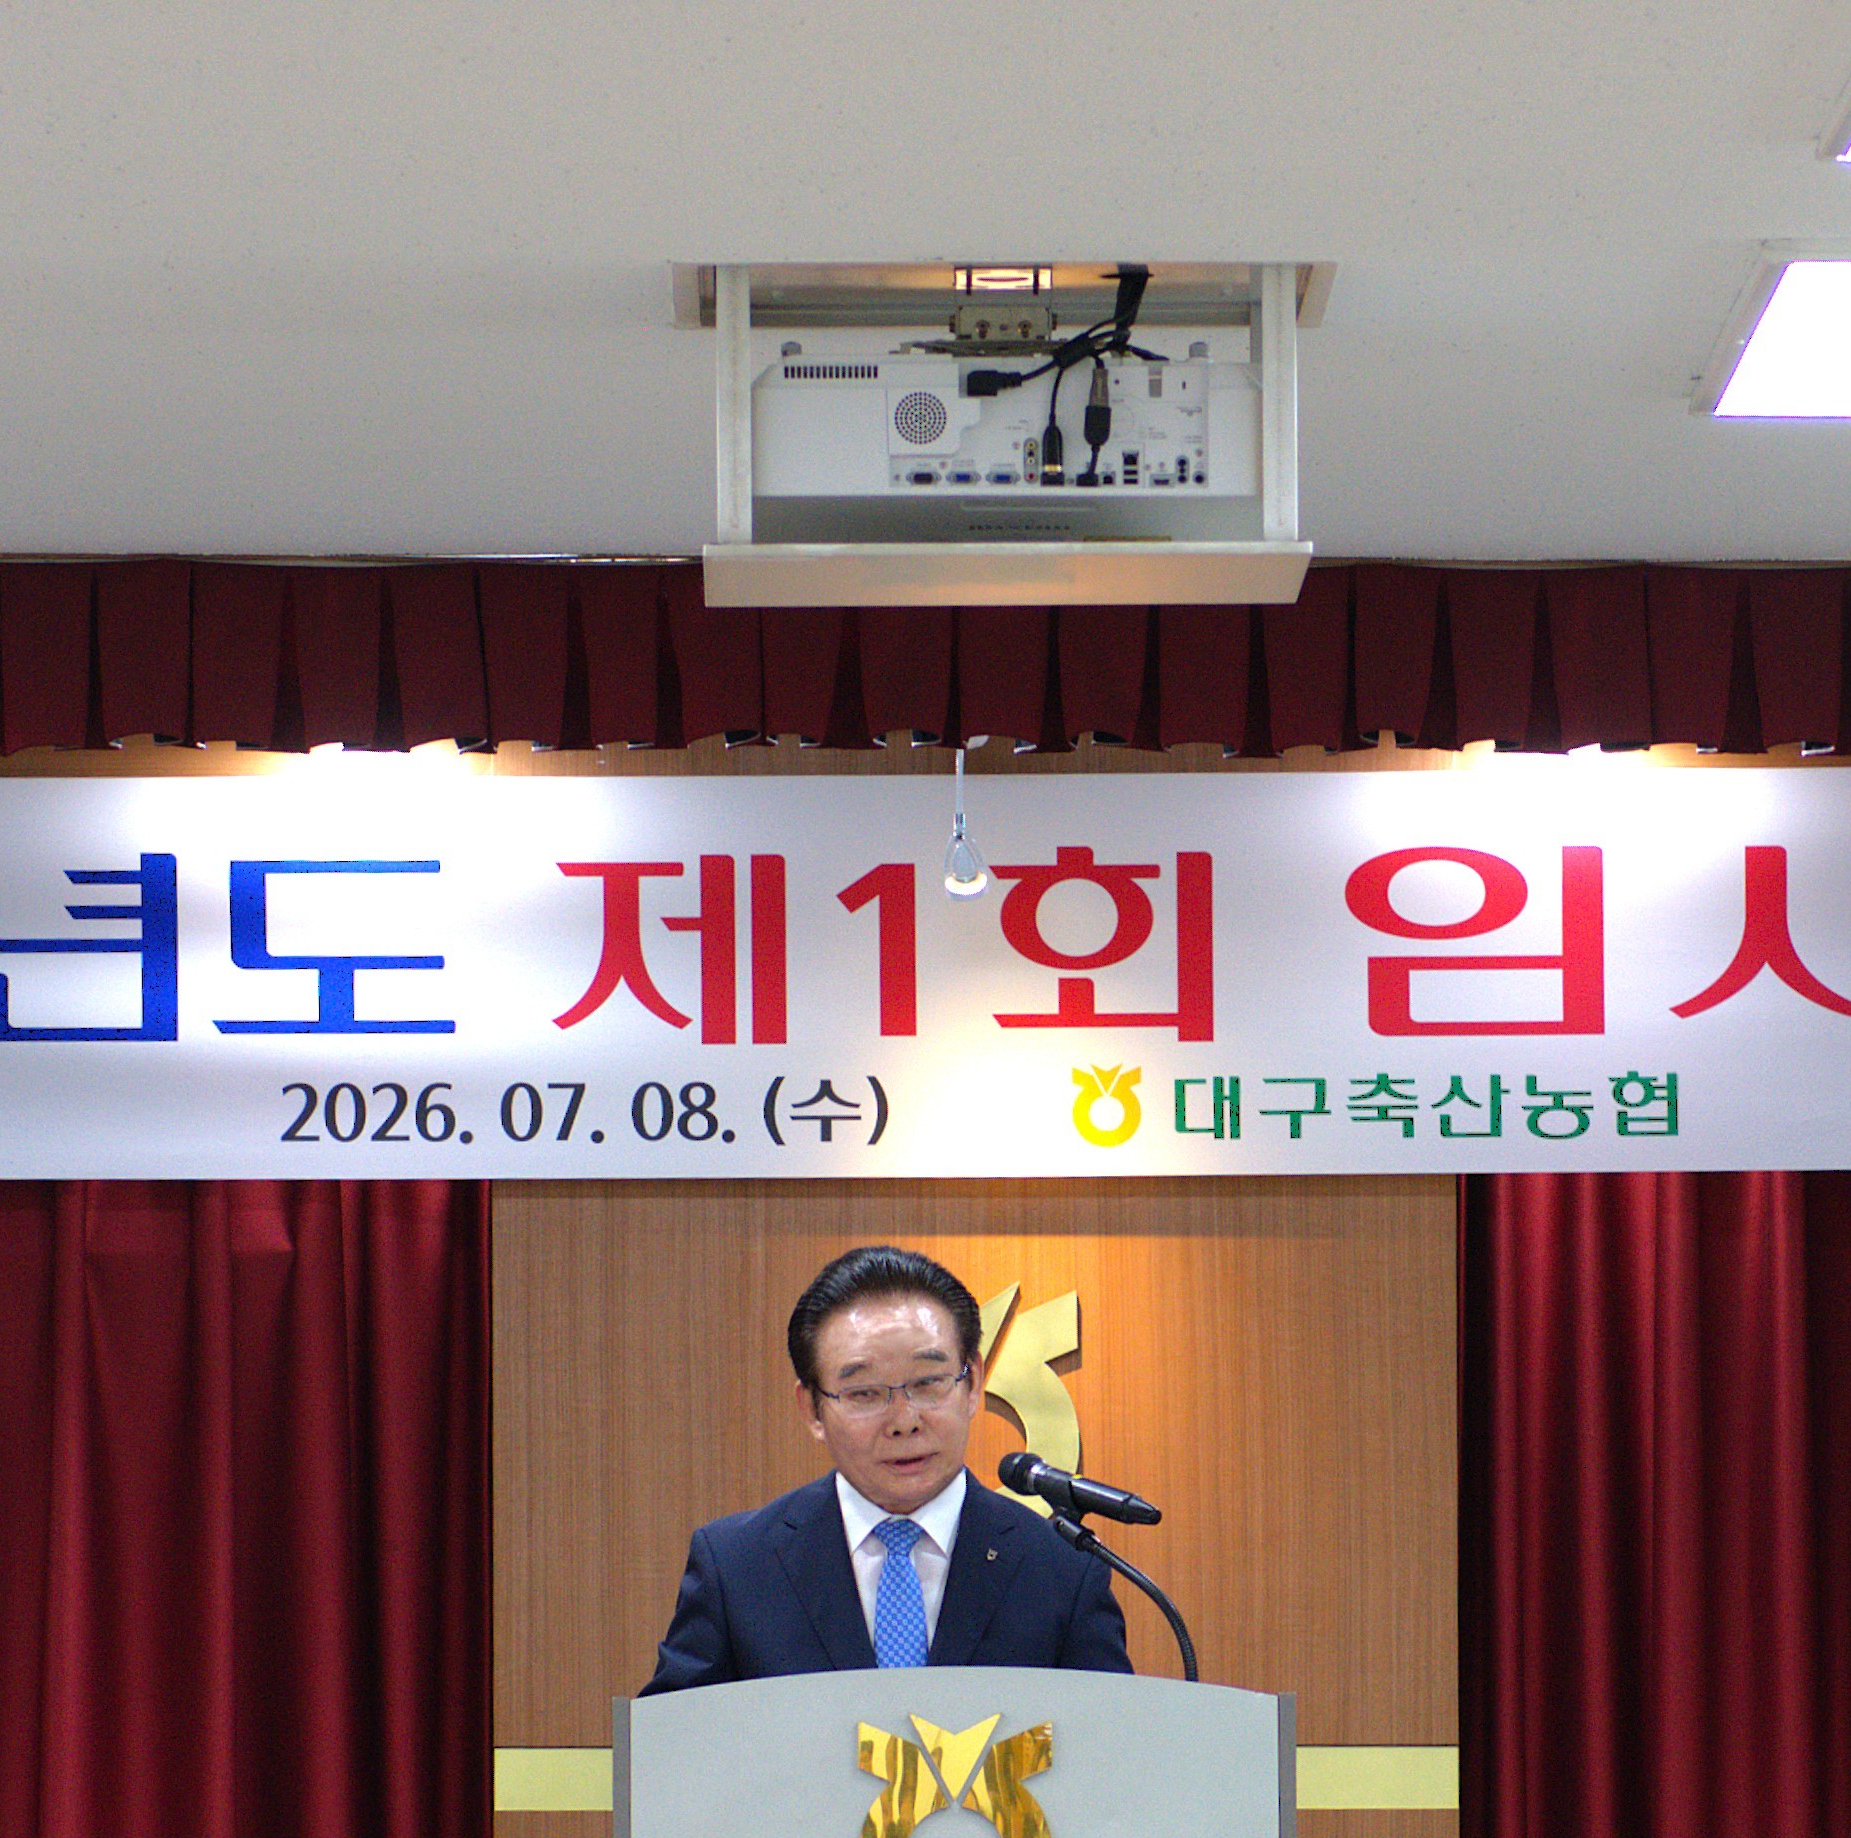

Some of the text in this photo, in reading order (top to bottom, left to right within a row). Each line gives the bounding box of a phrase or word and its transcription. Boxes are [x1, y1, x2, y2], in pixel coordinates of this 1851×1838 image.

[553, 846, 1215, 1045] 제1회
[281, 1076, 889, 1146] 2026. 07. 08. (수)
[1173, 1070, 1680, 1140] 대구축산농협
